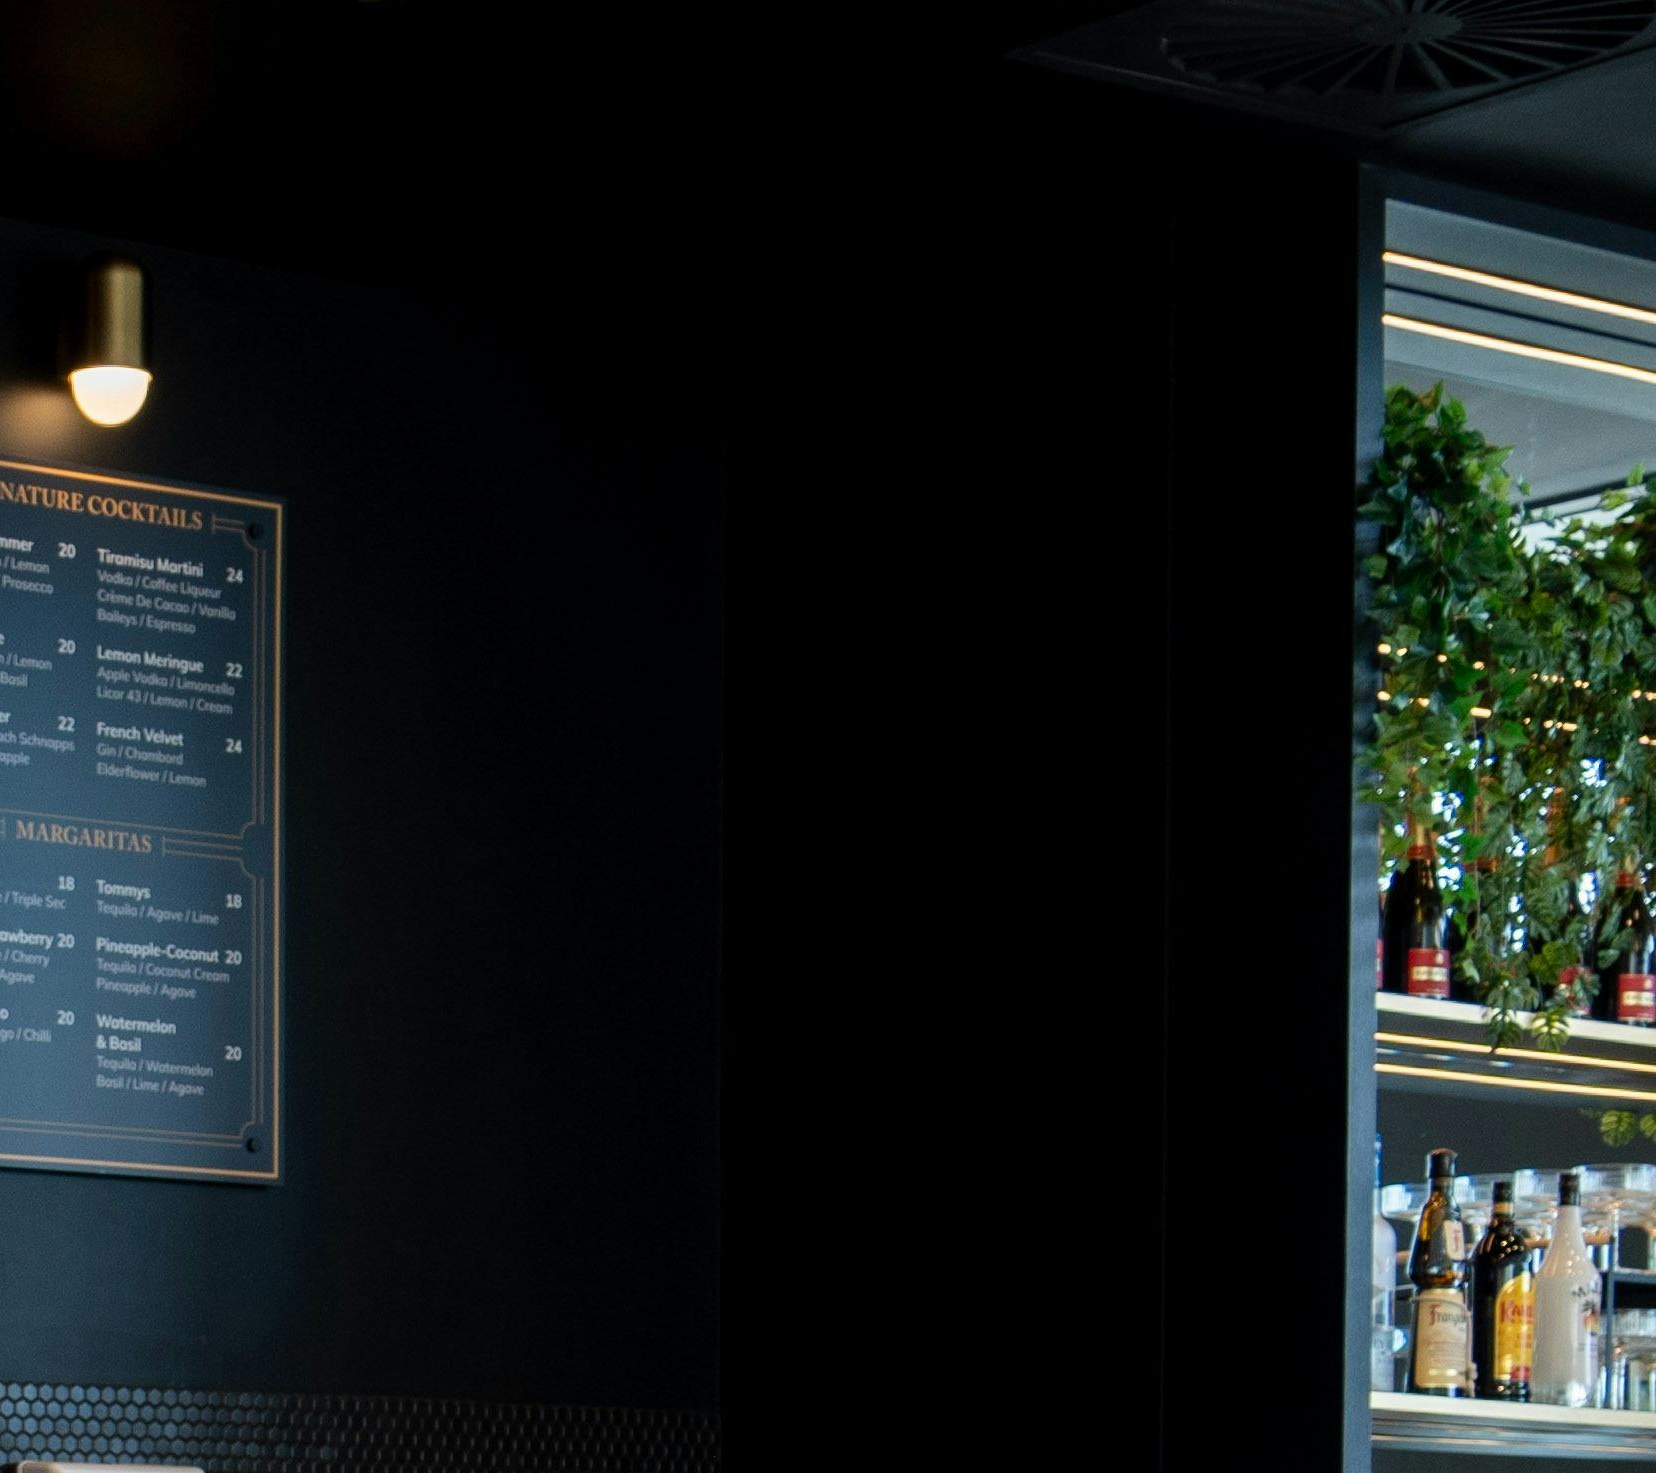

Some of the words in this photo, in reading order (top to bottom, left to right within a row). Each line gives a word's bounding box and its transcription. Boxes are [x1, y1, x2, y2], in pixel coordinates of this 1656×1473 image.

[87, 496, 201, 528] COCKTAILS
[59, 543, 76, 558] 20
[98, 548, 154, 570] Tiramisu
[157, 558, 203, 577] Martini
[227, 568, 243, 583] 24
[97, 645, 141, 664] Lemon
[144, 651, 203, 674] Meringue
[227, 663, 242, 678] 22
[97, 722, 140, 740] French
[143, 728, 183, 746] Velvet
[15, 819, 153, 854] MARGARITAS
[96, 879, 151, 901] Tommys
[96, 937, 218, 962] Pineapple-Coconut
[96, 1014, 176, 1034] Watermelon
